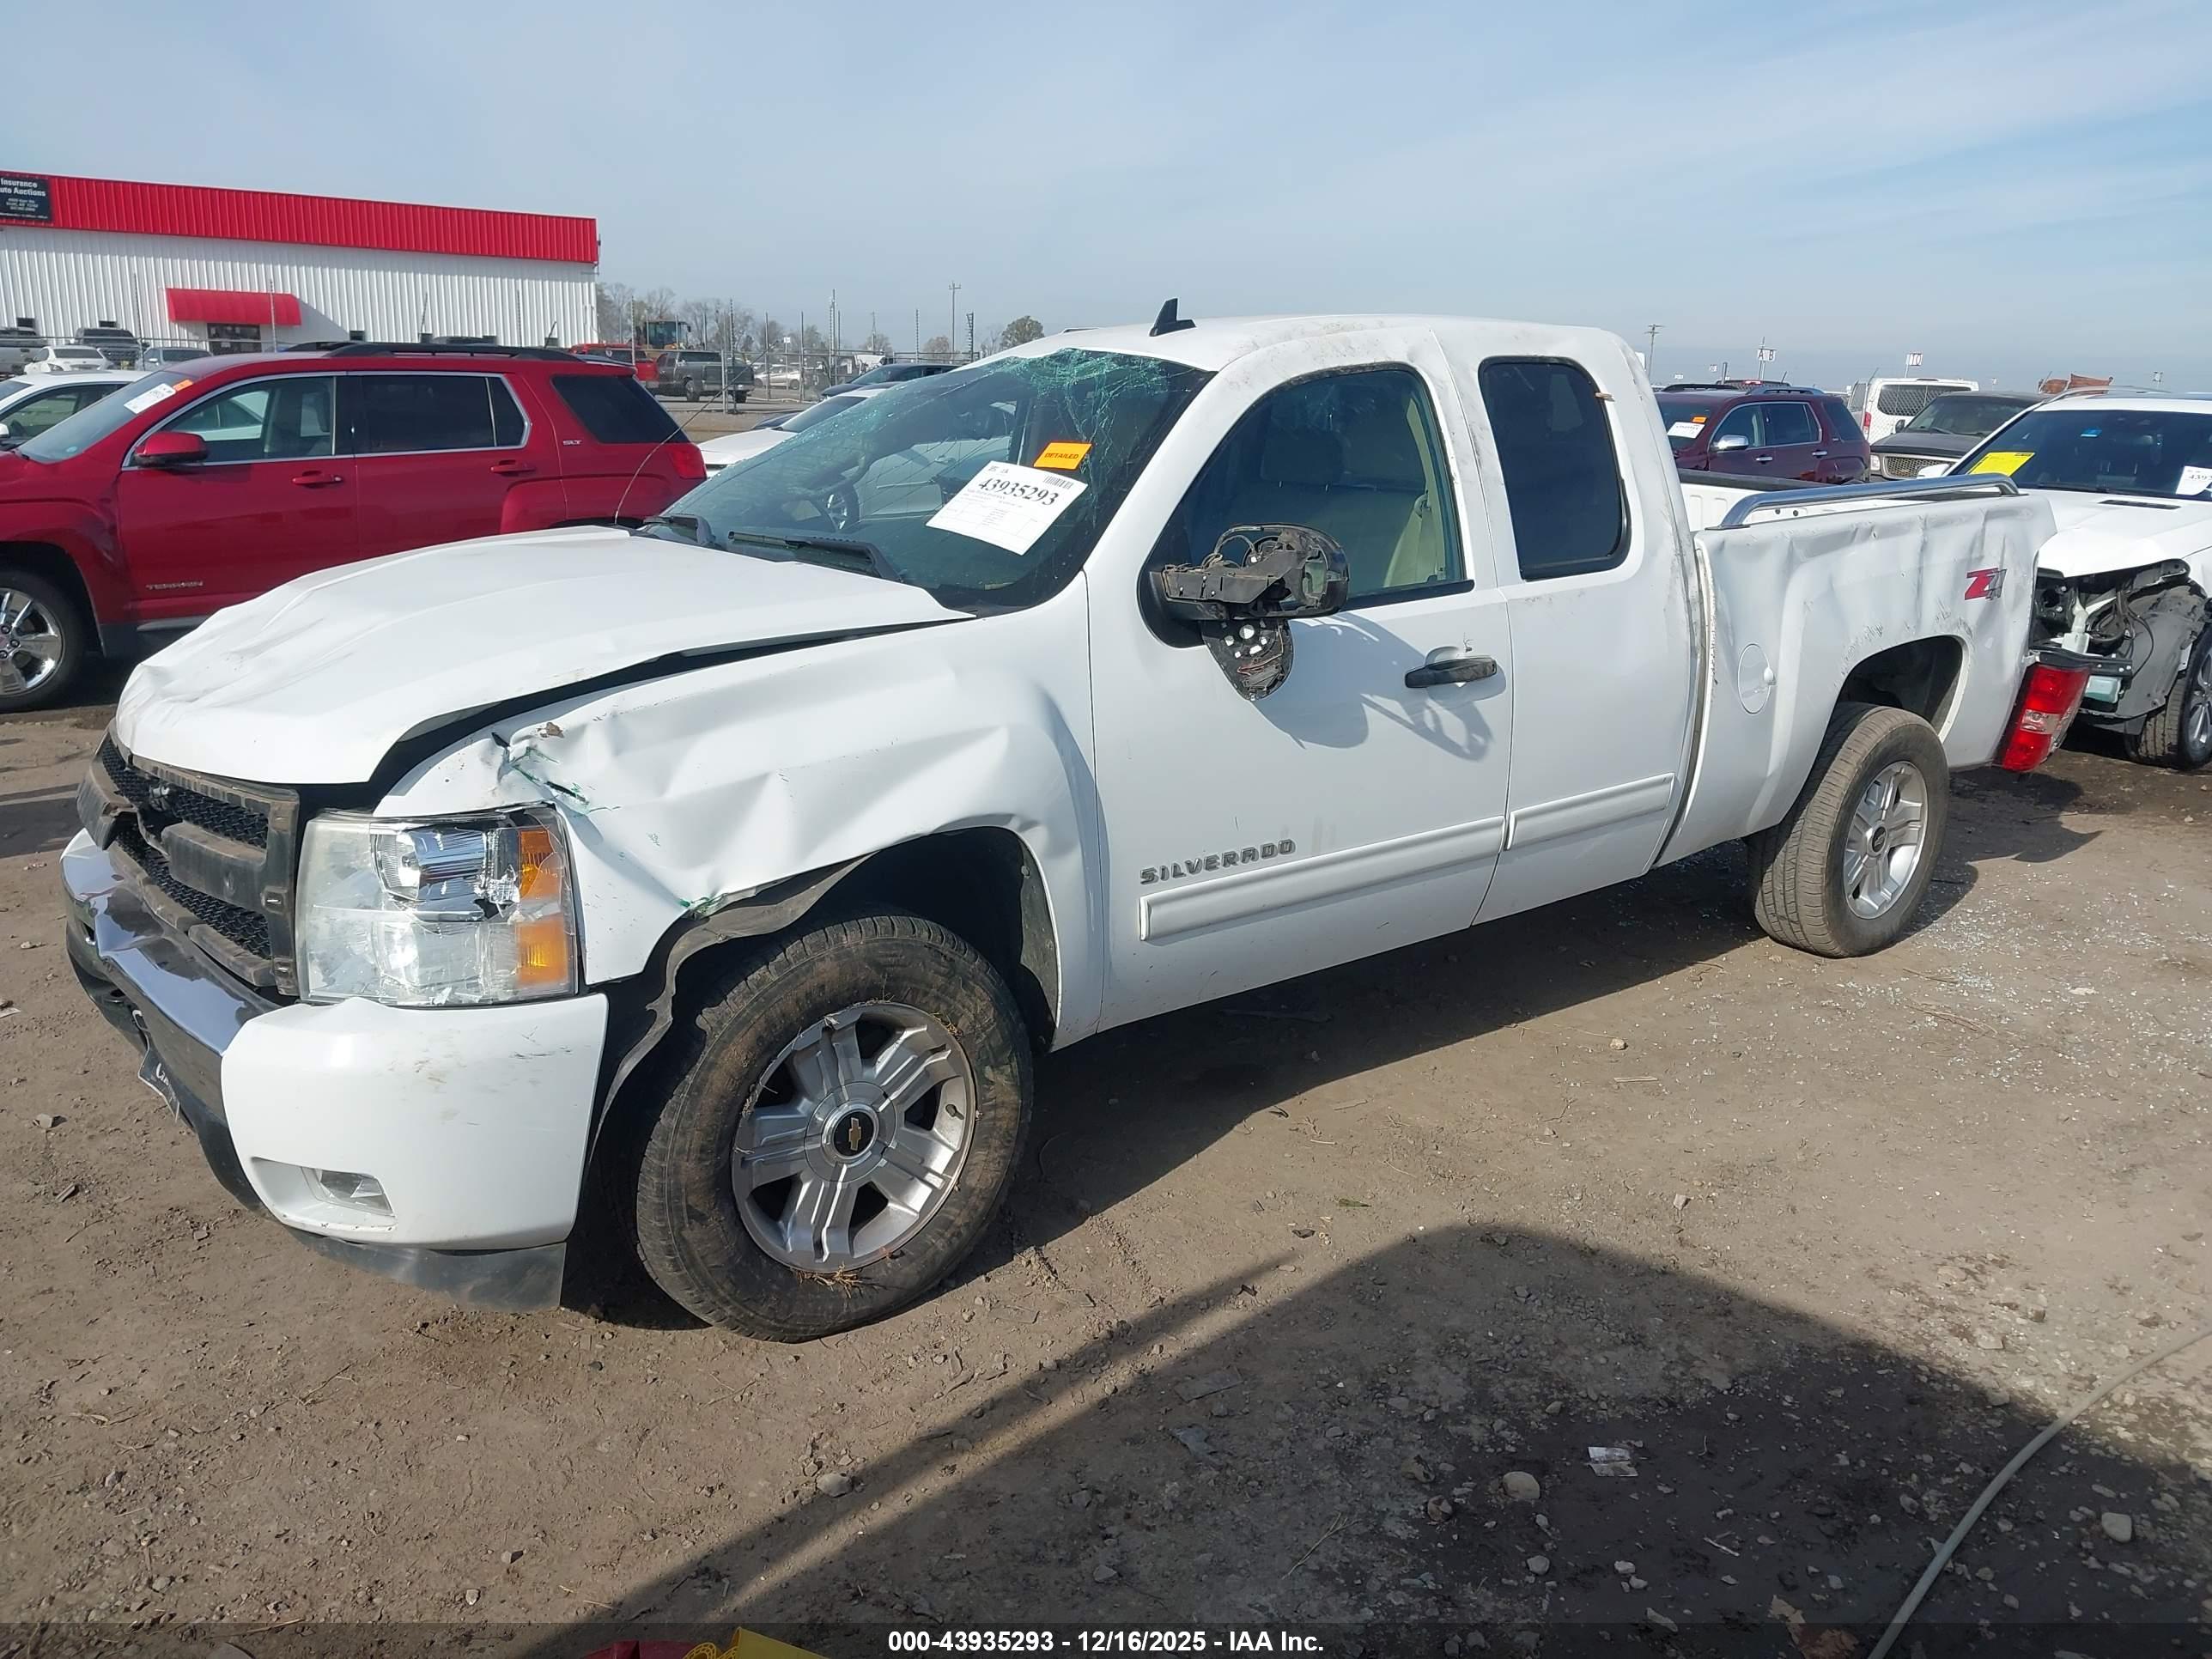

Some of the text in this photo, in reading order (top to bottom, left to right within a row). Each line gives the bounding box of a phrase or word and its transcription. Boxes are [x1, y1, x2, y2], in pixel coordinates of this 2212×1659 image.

[1, 178, 38, 188] Insurance
[14, 186, 46, 197] Auctions
[978, 477, 1059, 506] 43935293
[1140, 839, 1297, 885] SILVERADO
